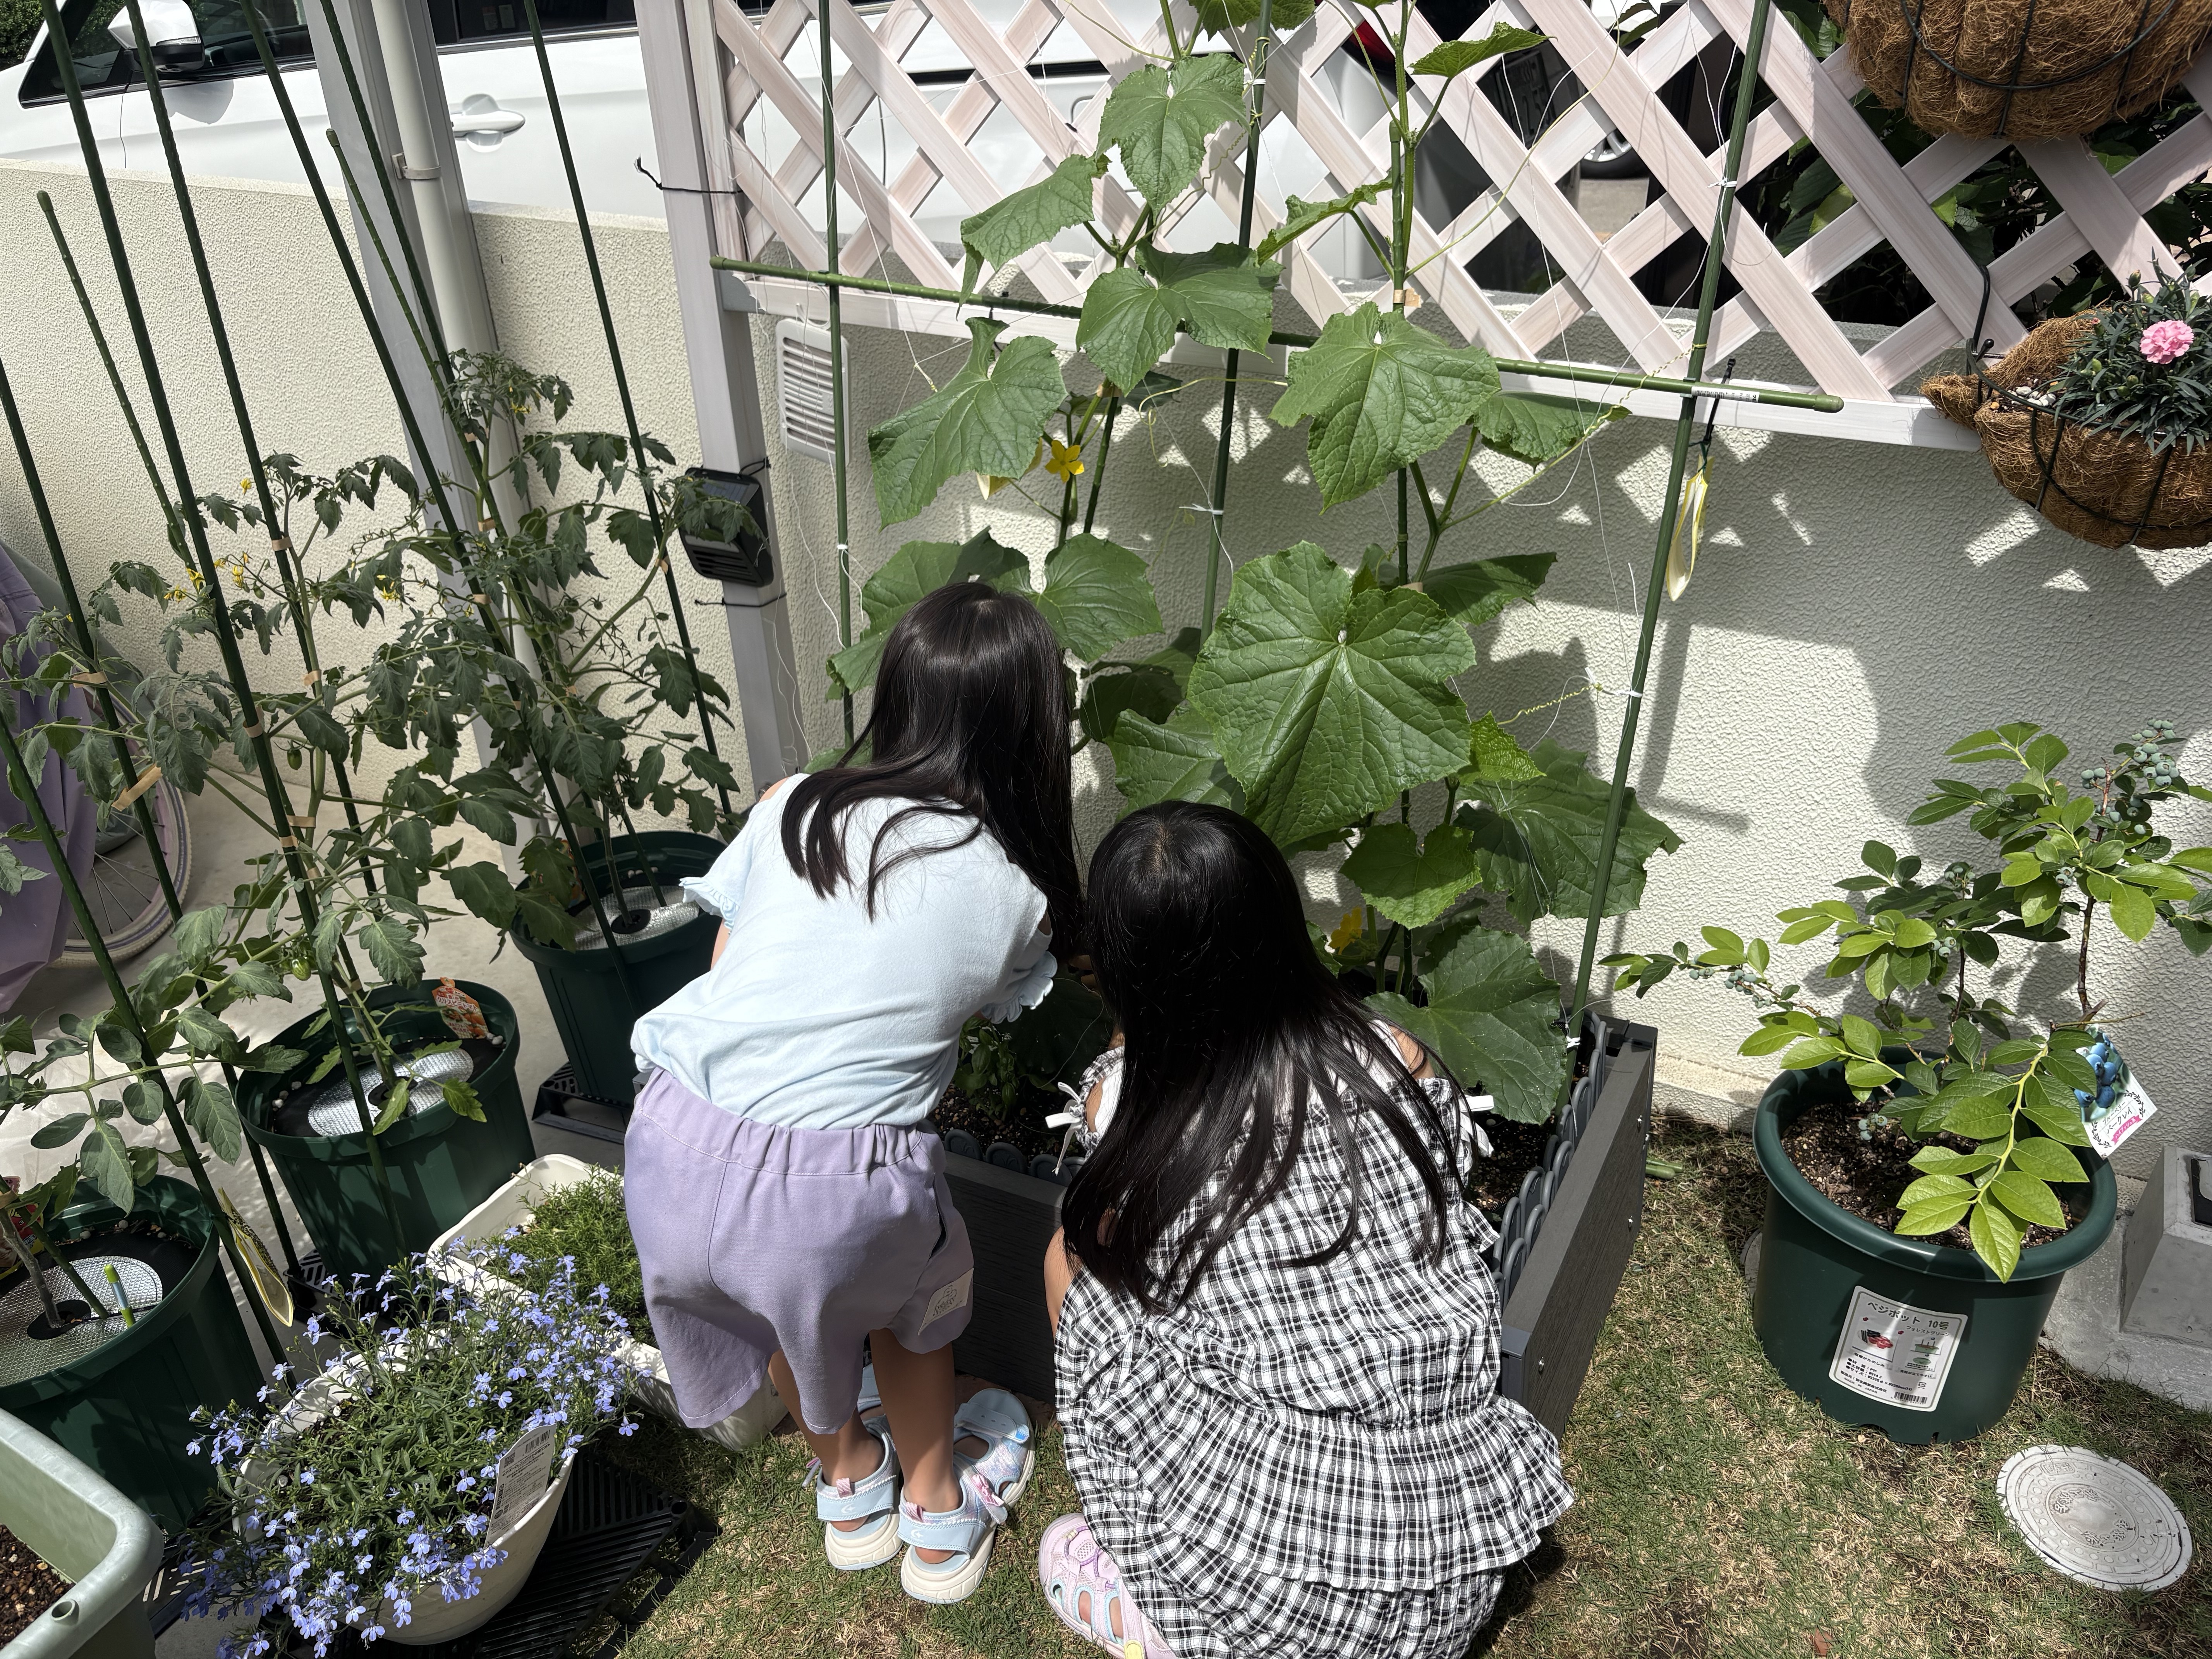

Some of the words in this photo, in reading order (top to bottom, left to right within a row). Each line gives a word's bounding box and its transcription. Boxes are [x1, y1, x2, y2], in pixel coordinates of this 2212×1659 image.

[2103, 1102, 2126, 1125] ブルーベリー
[2107, 1106, 2133, 1134] バークレイ
[1868, 1302, 1920, 1324] ベジポット
[1929, 1320, 1949, 1330] 10号
[1906, 1326, 1949, 1337] フォレストグリーン
